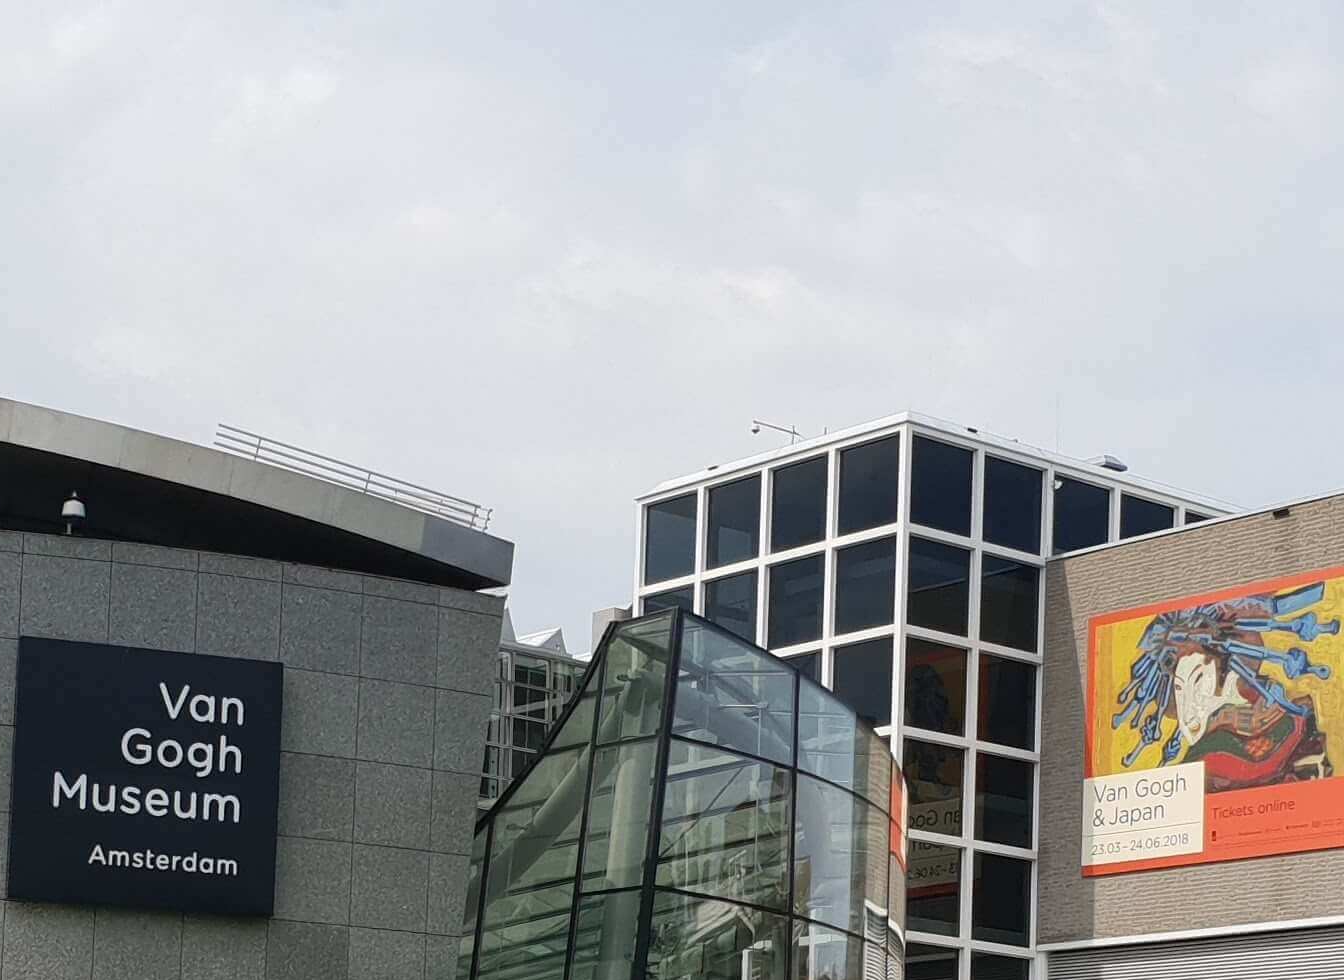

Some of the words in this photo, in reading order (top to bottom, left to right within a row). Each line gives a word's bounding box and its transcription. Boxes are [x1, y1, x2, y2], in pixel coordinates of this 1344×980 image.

[159, 682, 245, 726] Van
[121, 727, 243, 778] Gogh
[52, 771, 241, 824] Museum
[1094, 783, 1128, 803] Van
[1135, 773, 1187, 798] Gogh
[1092, 808, 1105, 828] &
[1109, 804, 1165, 827] Japan
[1212, 805, 1254, 820] Tickets
[1257, 799, 1296, 815] online
[87, 844, 239, 876] Amsterdam
